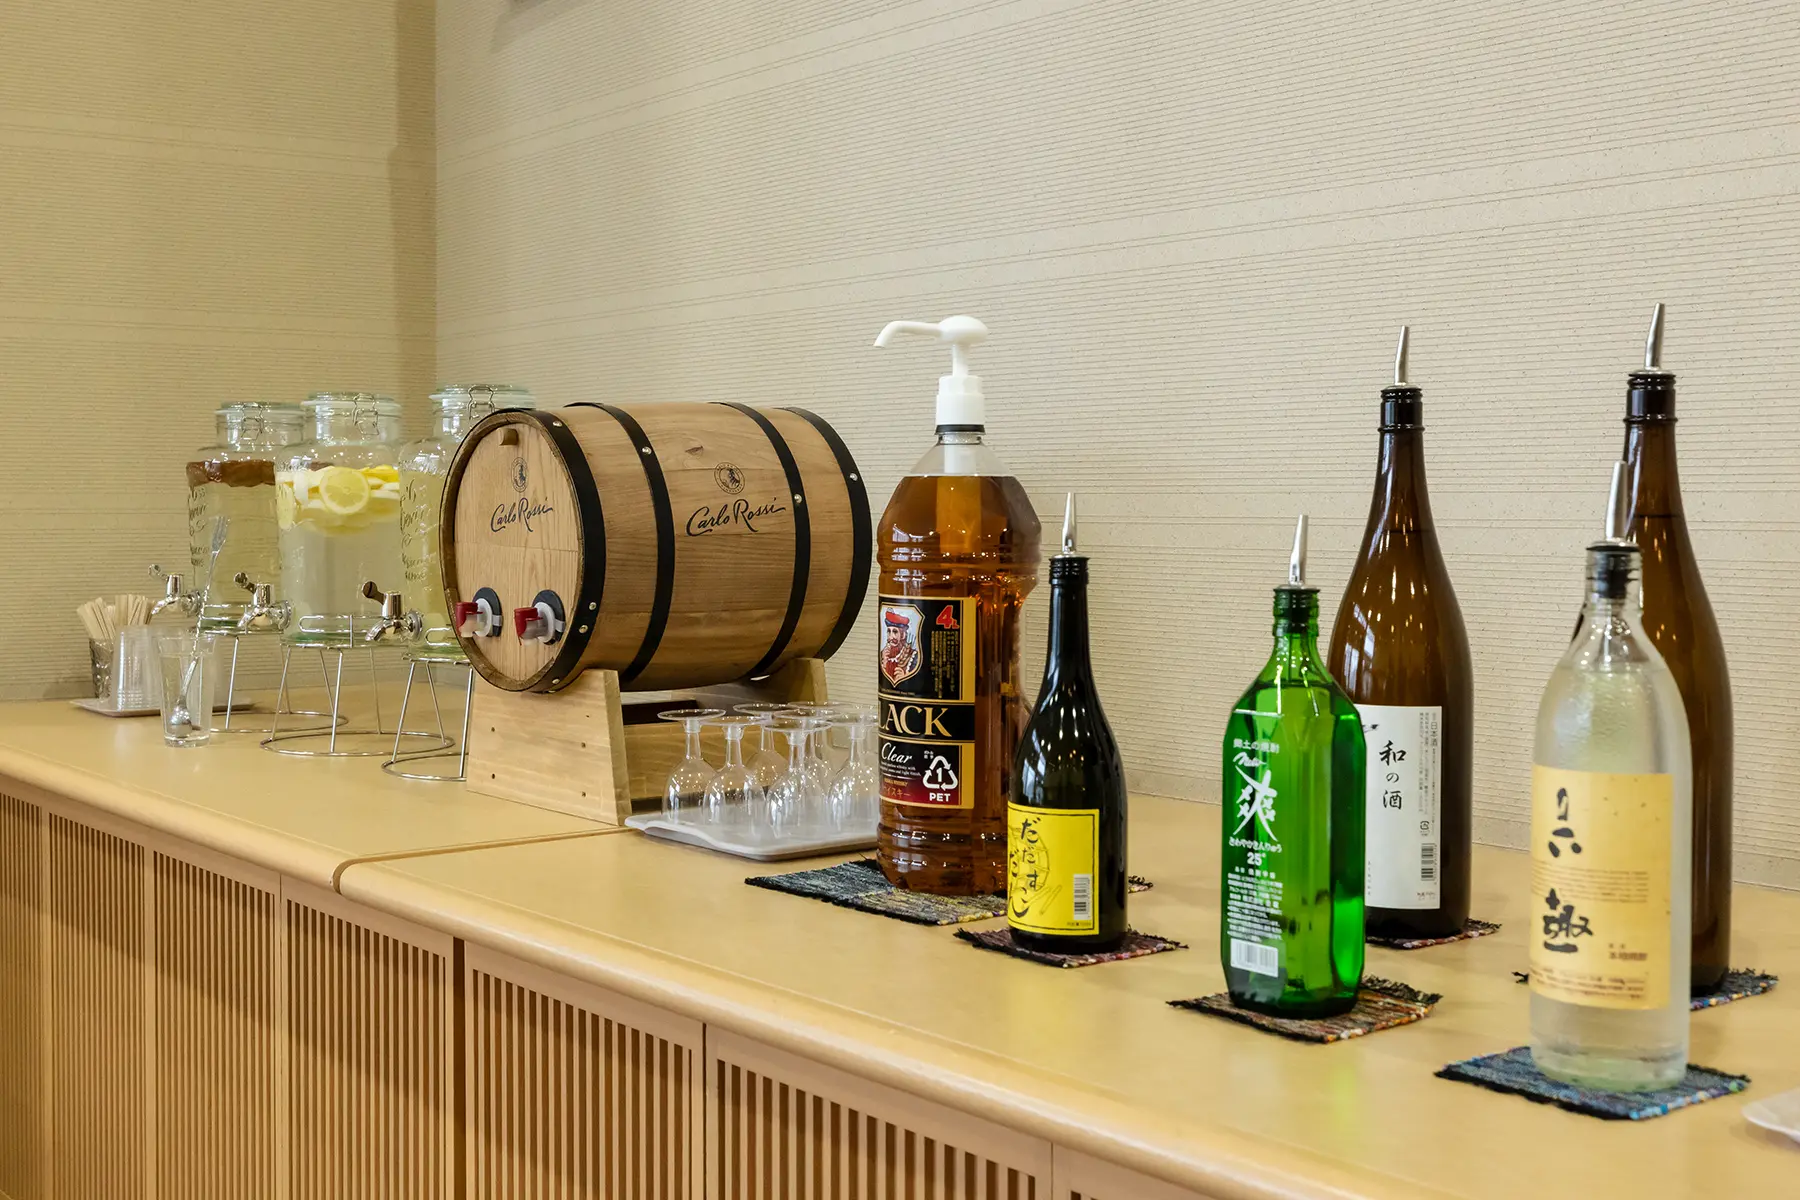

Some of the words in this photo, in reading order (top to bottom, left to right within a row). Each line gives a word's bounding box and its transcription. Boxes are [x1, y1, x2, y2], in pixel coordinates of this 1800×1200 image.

[491, 502, 516, 532] Carlo
[518, 496, 553, 532] Rossi
[686, 504, 730, 536] Carlo
[733, 497, 786, 532] Rossi
[878, 703, 952, 737] ACK
[881, 742, 913, 763] Clear
[936, 767, 942, 782] 1
[1378, 740, 1407, 810] 和の酒
[929, 792, 951, 802] PET
